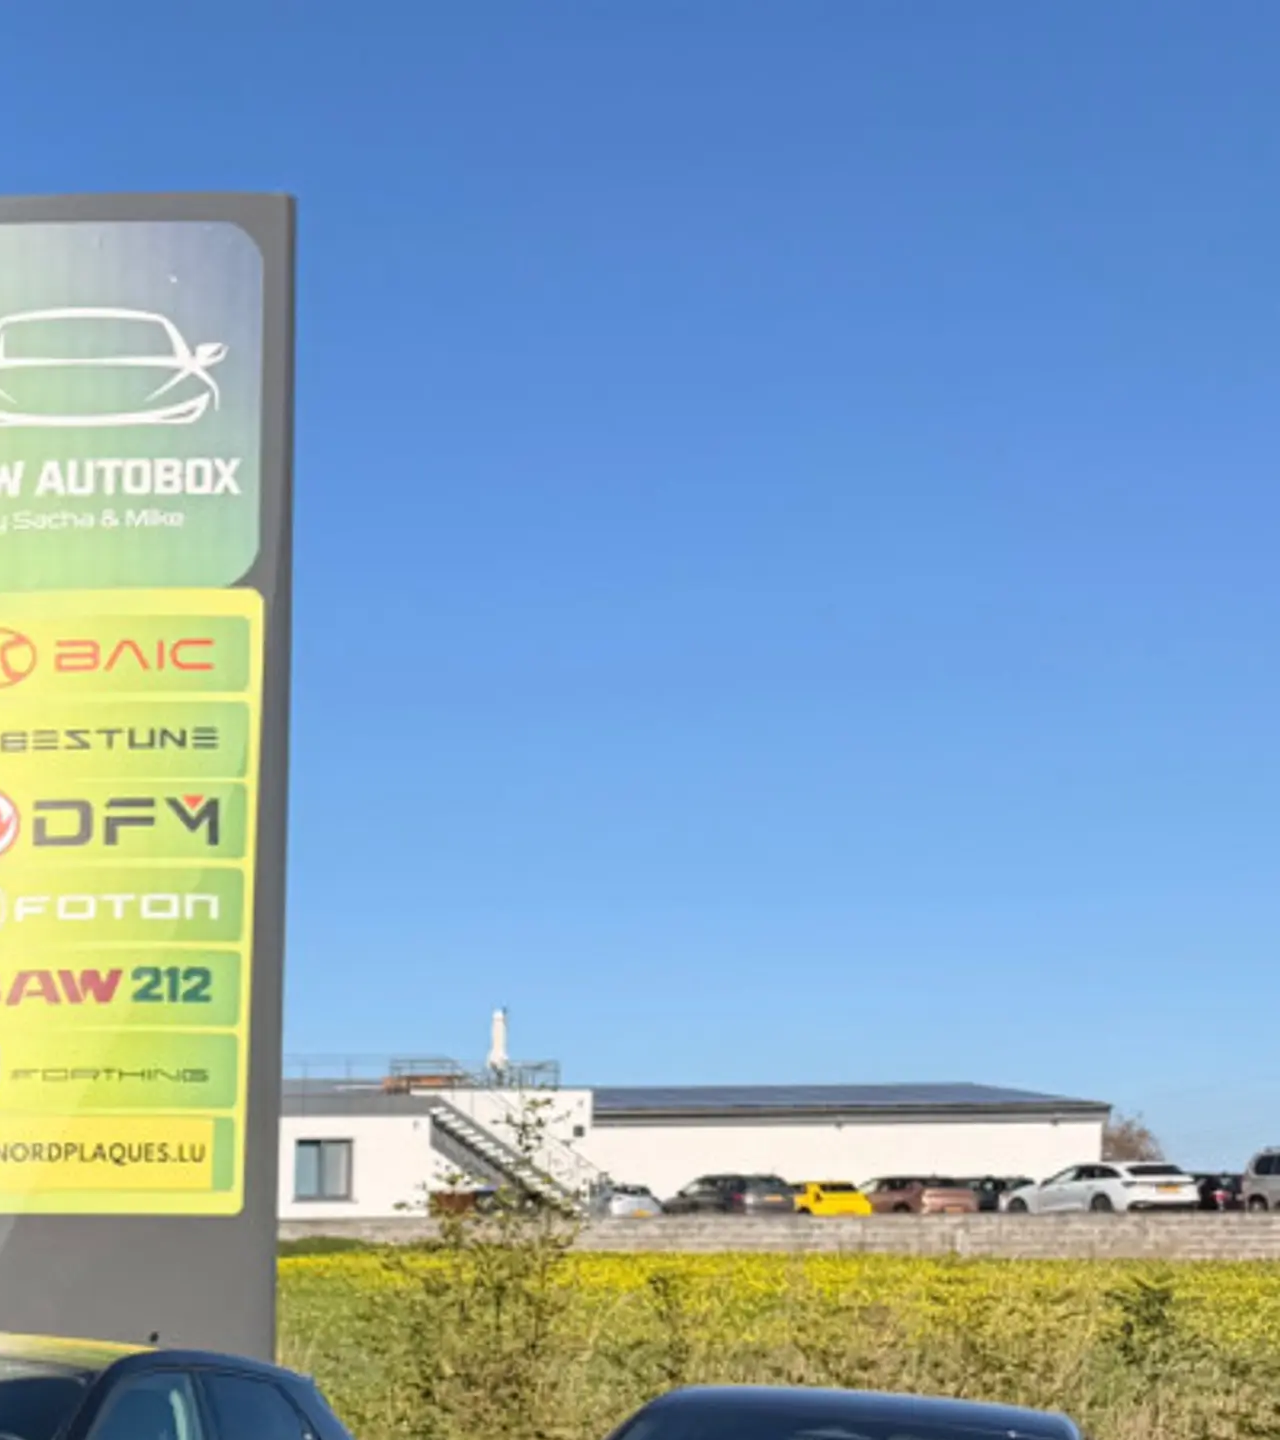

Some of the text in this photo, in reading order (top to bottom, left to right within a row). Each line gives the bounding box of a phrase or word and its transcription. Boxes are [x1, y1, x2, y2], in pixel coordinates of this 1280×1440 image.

[35, 457, 241, 497] AUTOBOX
[12, 510, 94, 531] Sacha
[100, 508, 120, 528] &
[125, 508, 185, 528] Mike
[53, 637, 215, 673] BAIC
[0, 726, 220, 752] BESTUNE
[31, 795, 220, 848] DFM
[13, 892, 220, 923] FOTON
[130, 966, 212, 1003] 212
[8, 1067, 210, 1084] FORTHING
